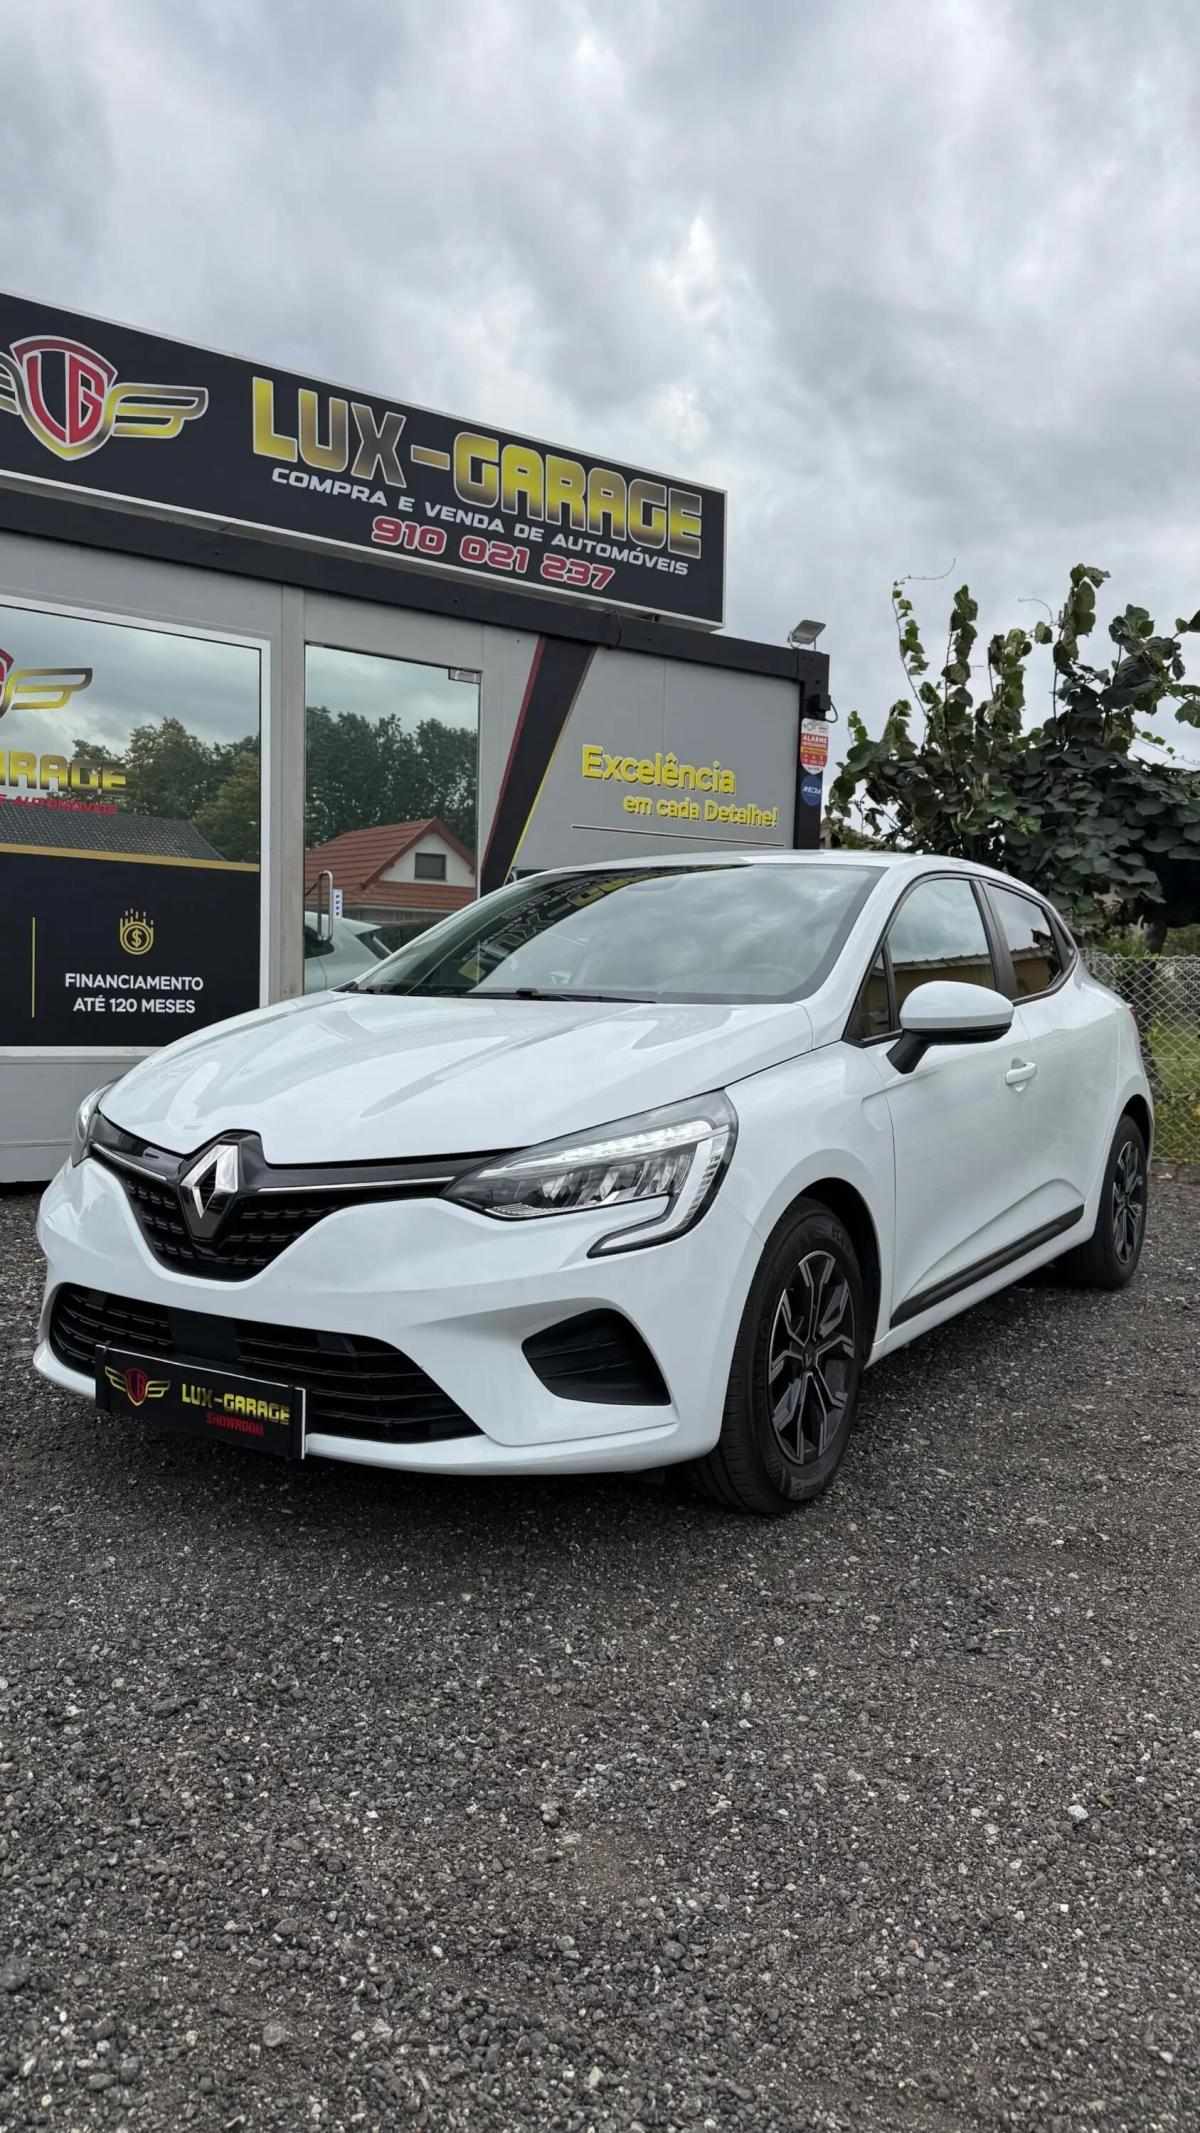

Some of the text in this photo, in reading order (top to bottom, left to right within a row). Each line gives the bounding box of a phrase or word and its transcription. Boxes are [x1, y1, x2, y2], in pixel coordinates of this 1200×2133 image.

[252, 376, 703, 559] LUX-GARAGE
[271, 467, 688, 576] COMPRA E VENDA DE AUTOMÓVEIS
[371, 515, 616, 590] 910 021 237
[581, 743, 736, 795] Excelência
[623, 793, 779, 829] em cada Detalhe!
[64, 972, 204, 991] FINANCIAMENTO
[72, 994, 196, 1014] ATÉ 120 MESES
[181, 1383, 289, 1425] LUX-GARAGE
